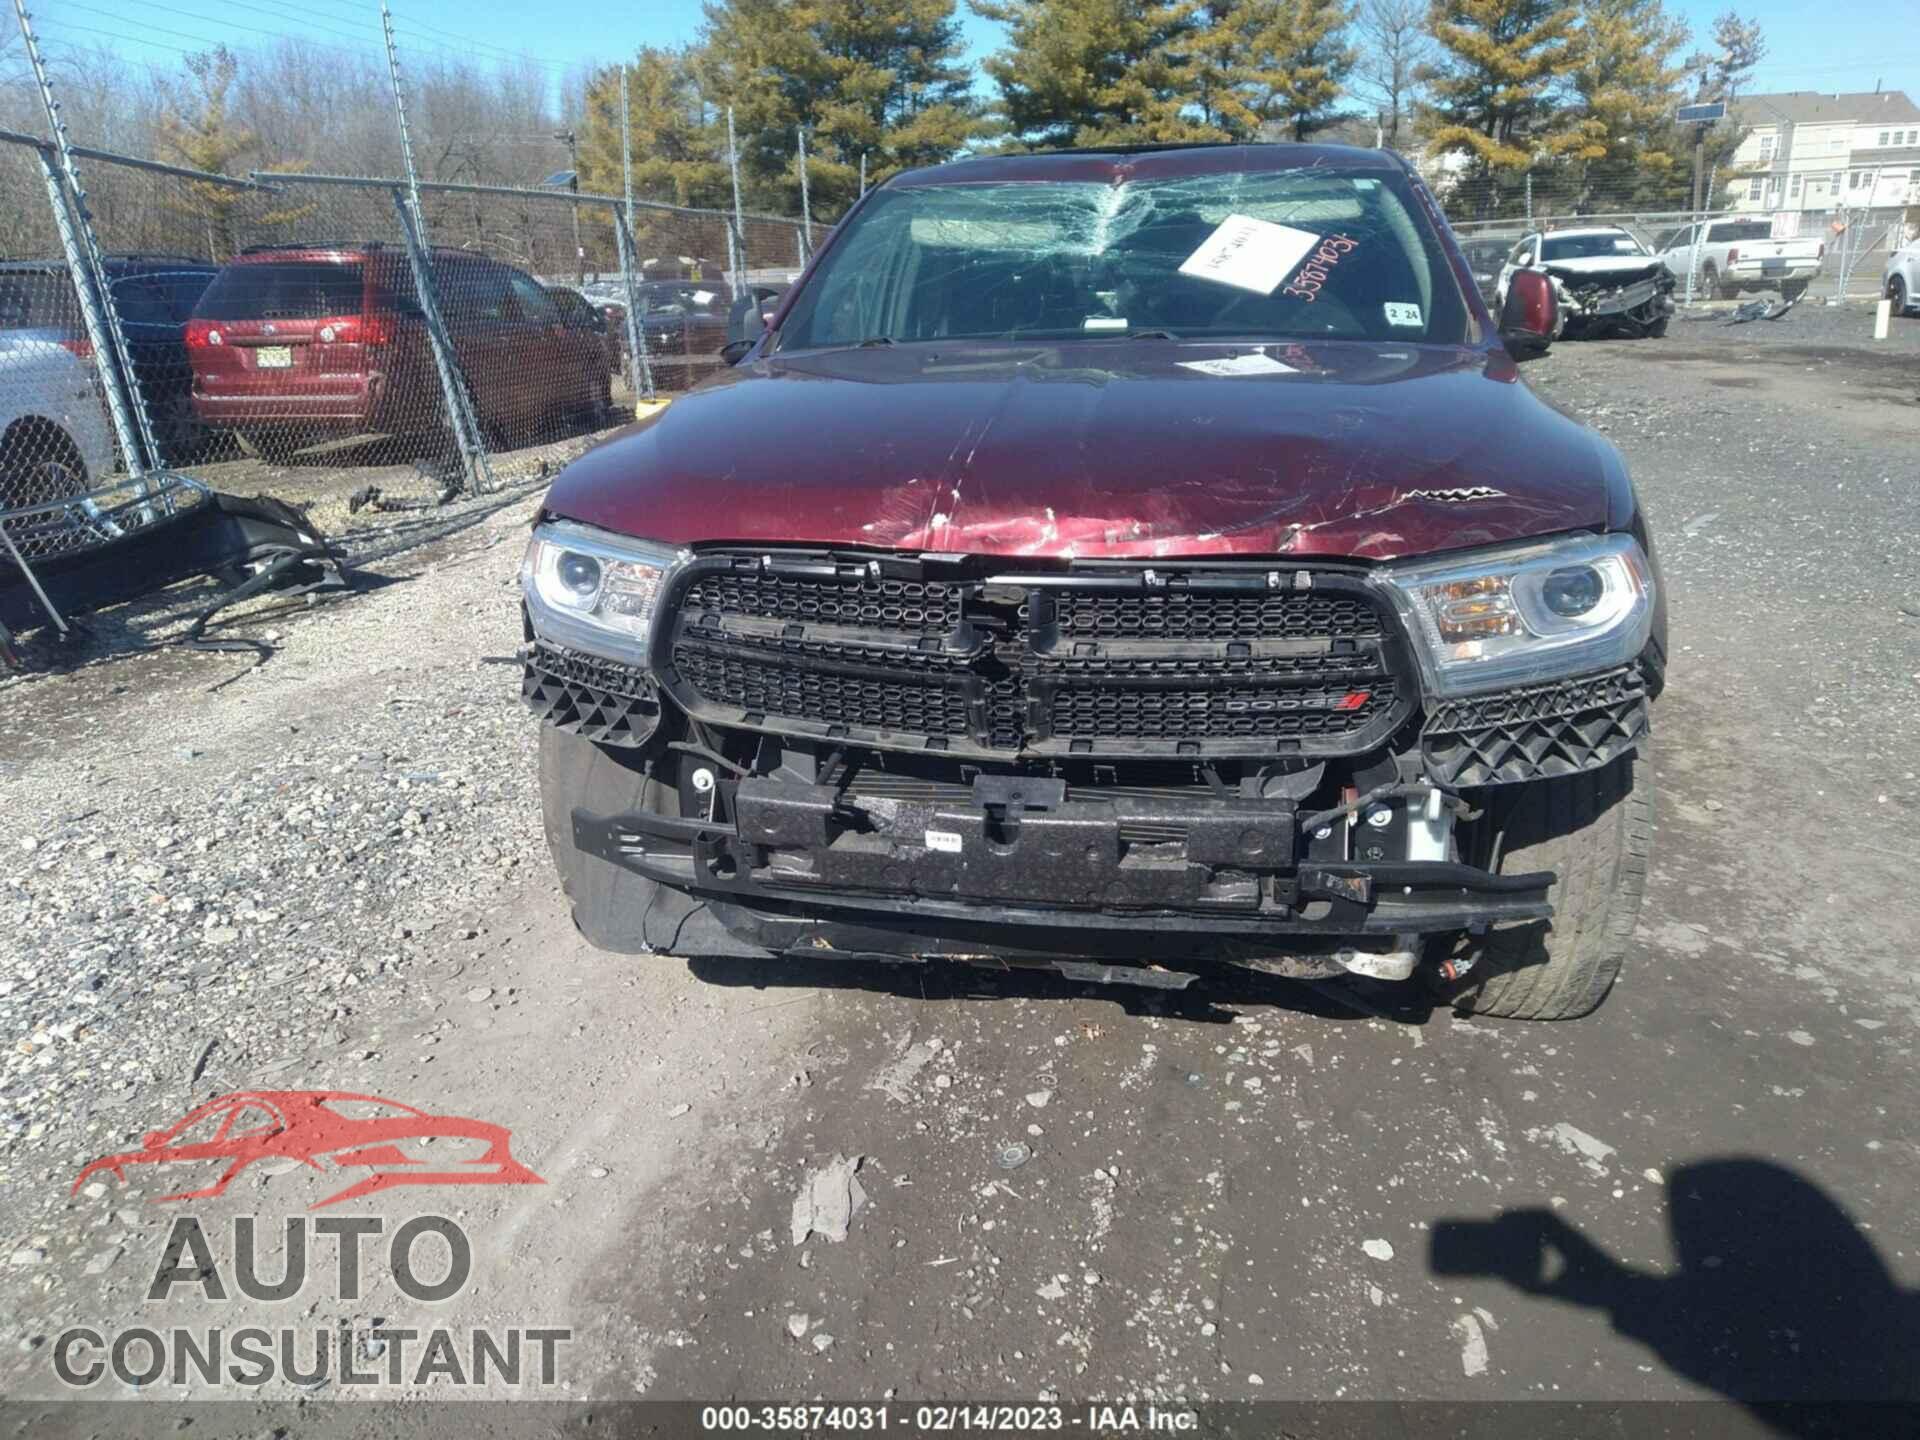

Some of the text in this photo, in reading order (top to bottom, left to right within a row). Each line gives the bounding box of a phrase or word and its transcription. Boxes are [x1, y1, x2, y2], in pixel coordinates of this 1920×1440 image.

[1283, 232, 1359, 302] 35874031
[1390, 308, 1418, 320] 2 24
